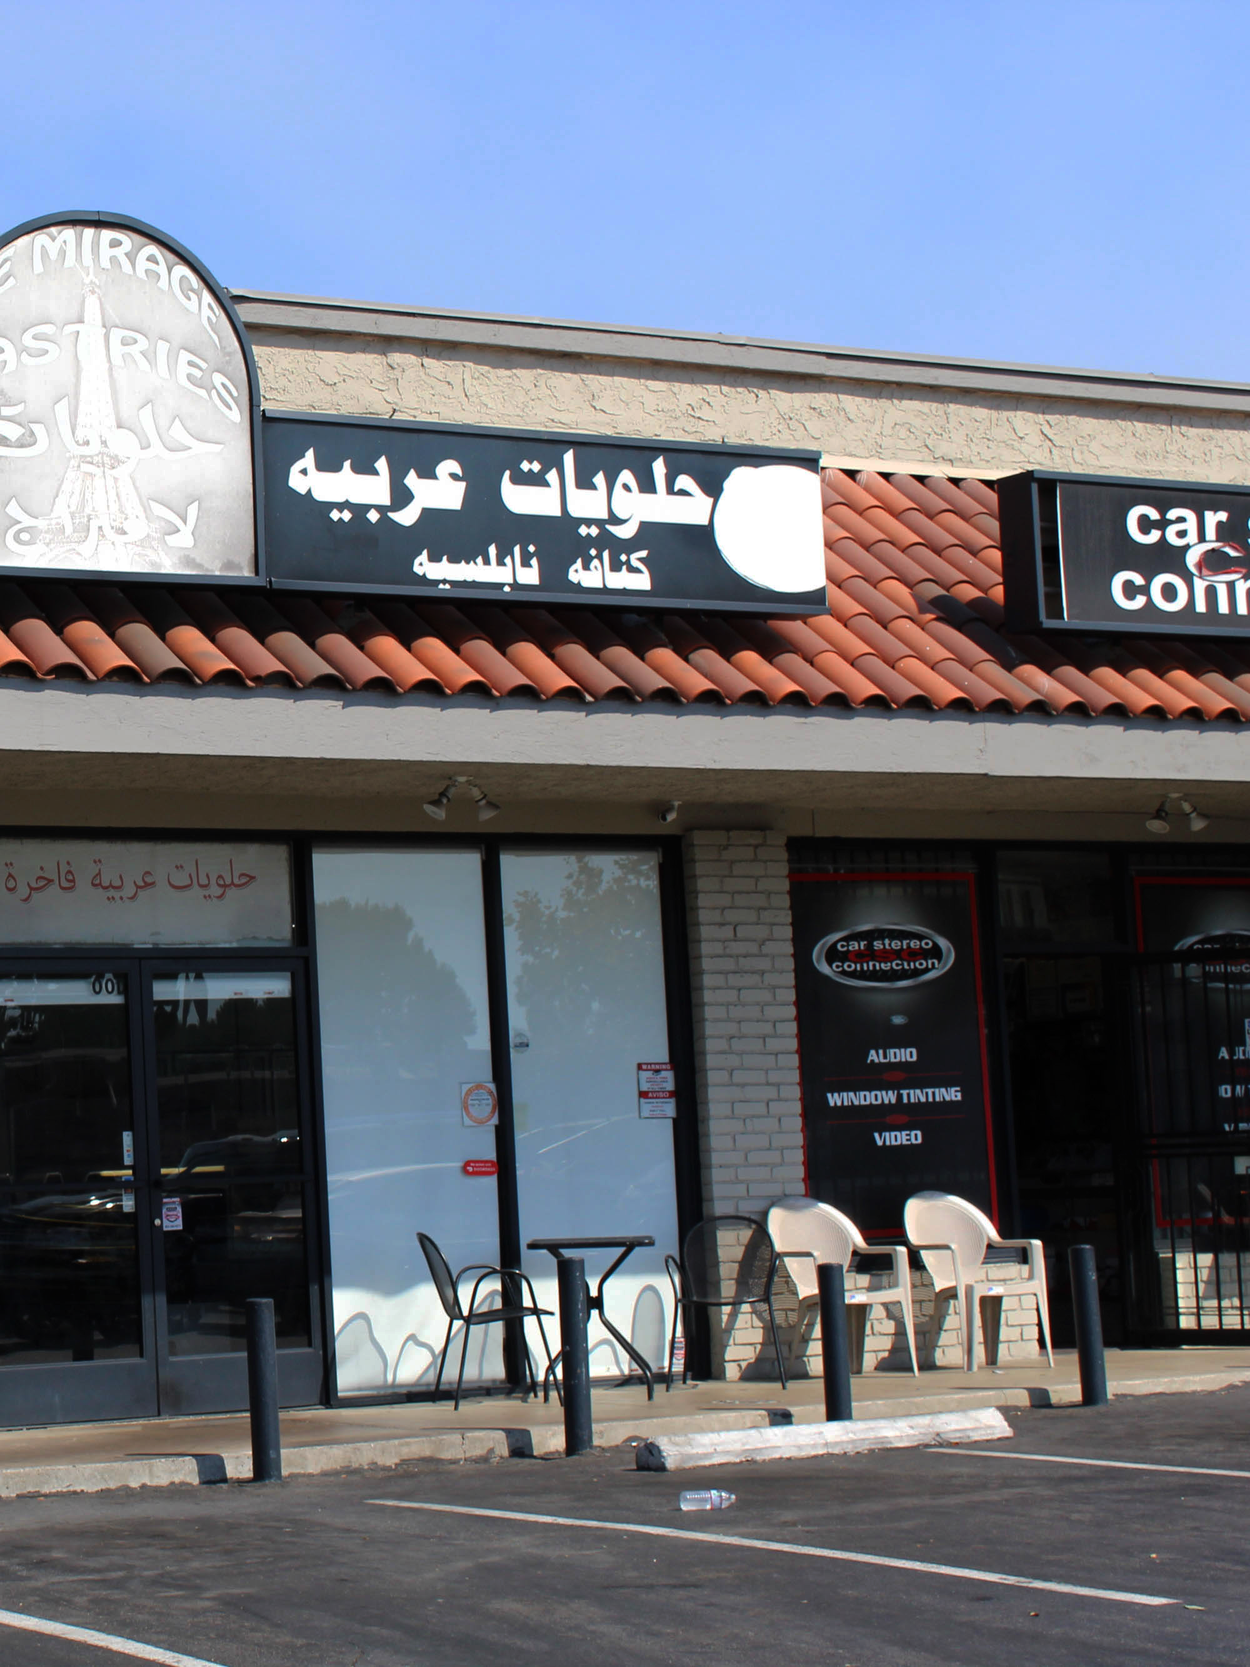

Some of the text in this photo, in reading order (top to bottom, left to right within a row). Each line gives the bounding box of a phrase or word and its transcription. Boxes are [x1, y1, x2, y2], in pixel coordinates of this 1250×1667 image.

[32, 228, 220, 351] MIRAGE
[287, 446, 715, 540] حلويات عربيه
[1126, 504, 1229, 547] car
[567, 548, 652, 591] كنافه
[3, 857, 257, 904] حلويات عربية فاخرة
[836, 938, 934, 952] car stereo
[831, 958, 940, 972] connection
[866, 1048, 918, 1064] AUDIO
[826, 1086, 962, 1107] WINDOW TINTING
[873, 1130, 923, 1146] VIDEO
